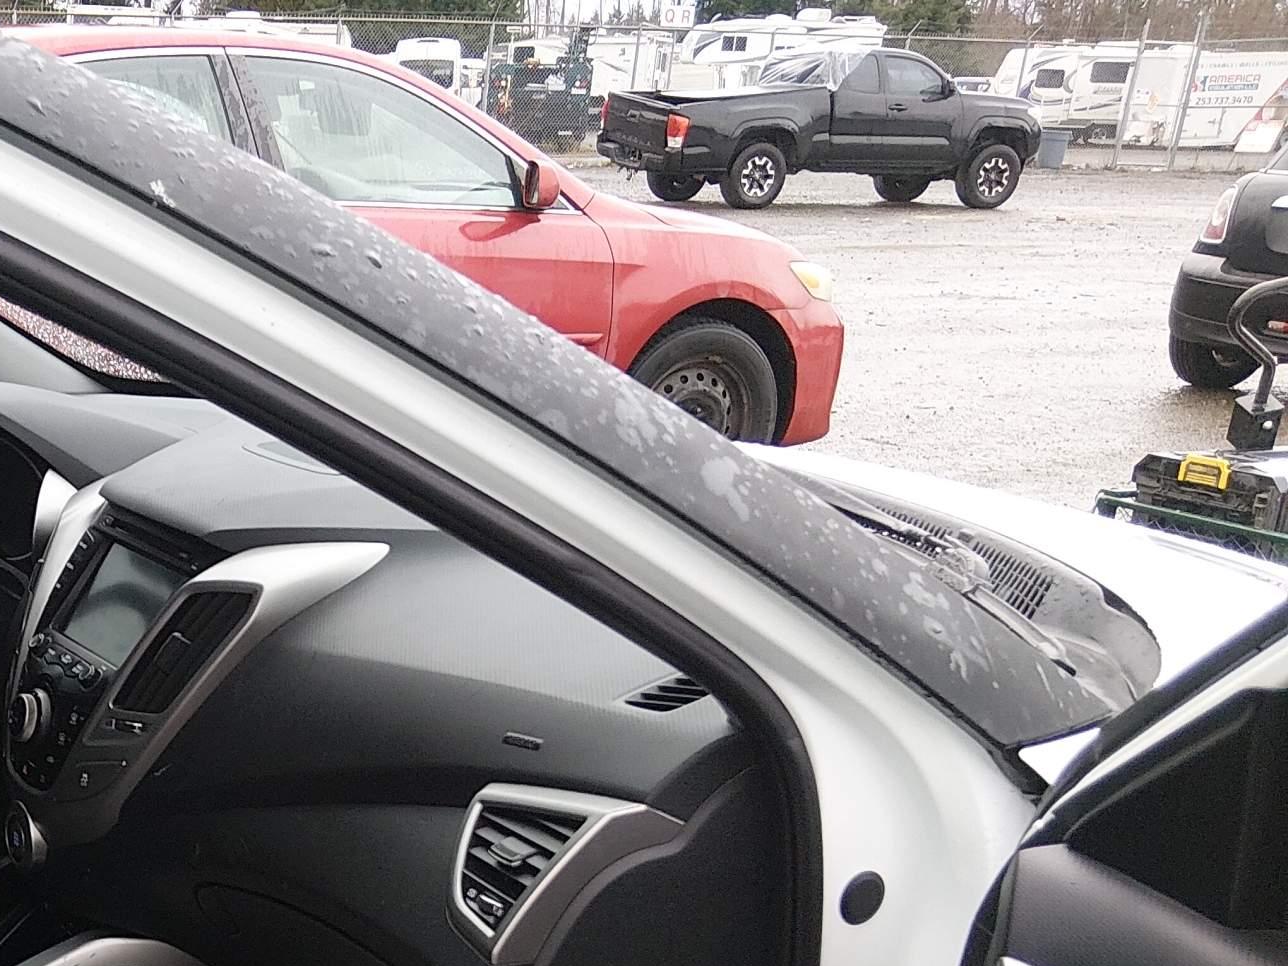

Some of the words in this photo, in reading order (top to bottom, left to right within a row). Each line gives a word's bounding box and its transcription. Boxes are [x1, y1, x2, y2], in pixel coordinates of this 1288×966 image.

[665, 9, 675, 23] Q
[682, 10, 691, 23] R
[1209, 74, 1261, 84] AMERICA
[1195, 96, 1253, 105] 253.737.3470
